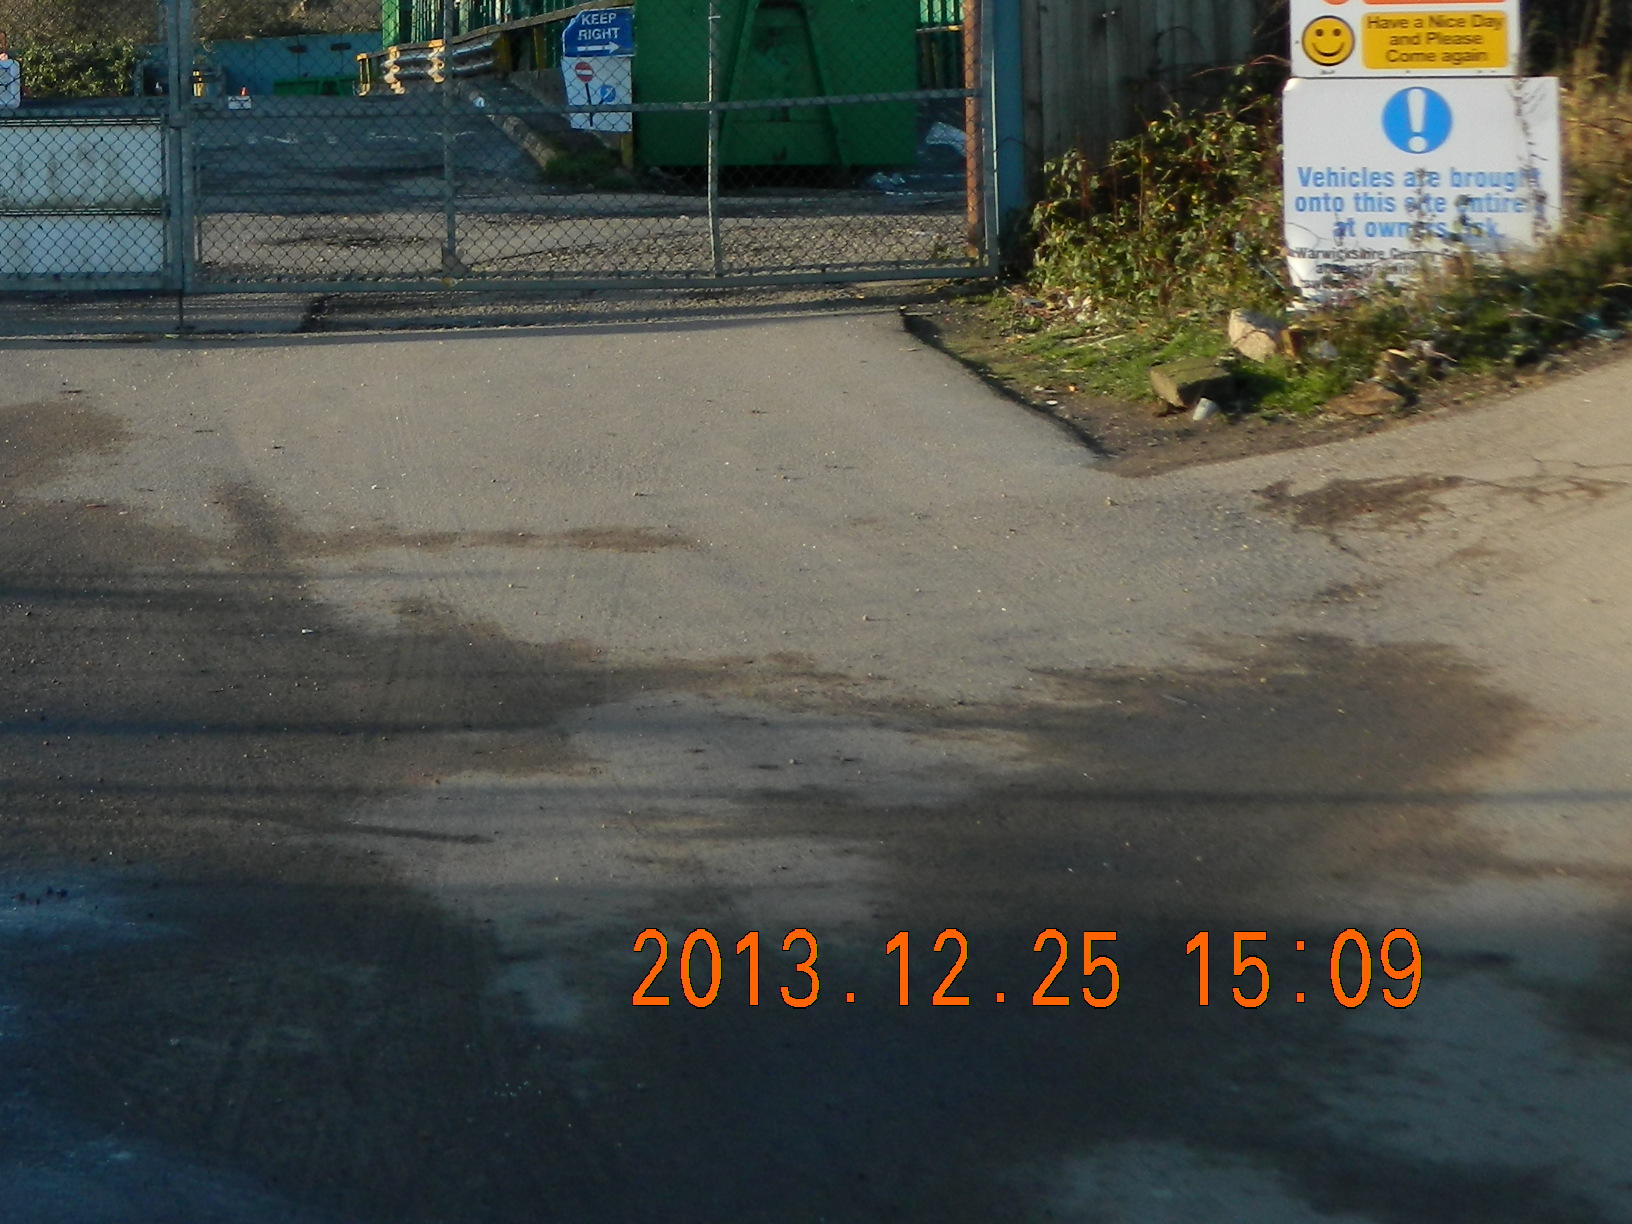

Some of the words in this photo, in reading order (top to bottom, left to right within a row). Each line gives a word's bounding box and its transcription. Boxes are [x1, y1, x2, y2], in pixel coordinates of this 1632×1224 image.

[581, 12, 617, 26] KEEP
[1367, 15, 1409, 30] Have
[1413, 18, 1423, 29] a
[1428, 14, 1466, 28] Nice
[1470, 14, 1503, 31] Day
[577, 27, 620, 41] RIGHT
[1389, 32, 1421, 45] and
[1426, 31, 1484, 45] Please
[1385, 49, 1436, 63] Come
[1441, 48, 1488, 65] again
[1297, 166, 1395, 188] Vehicles
[1295, 192, 1344, 213] onto
[1353, 192, 1396, 213] this
[1457, 193, 1545, 218] ntire
[1365, 221, 1447, 238] ownrs
